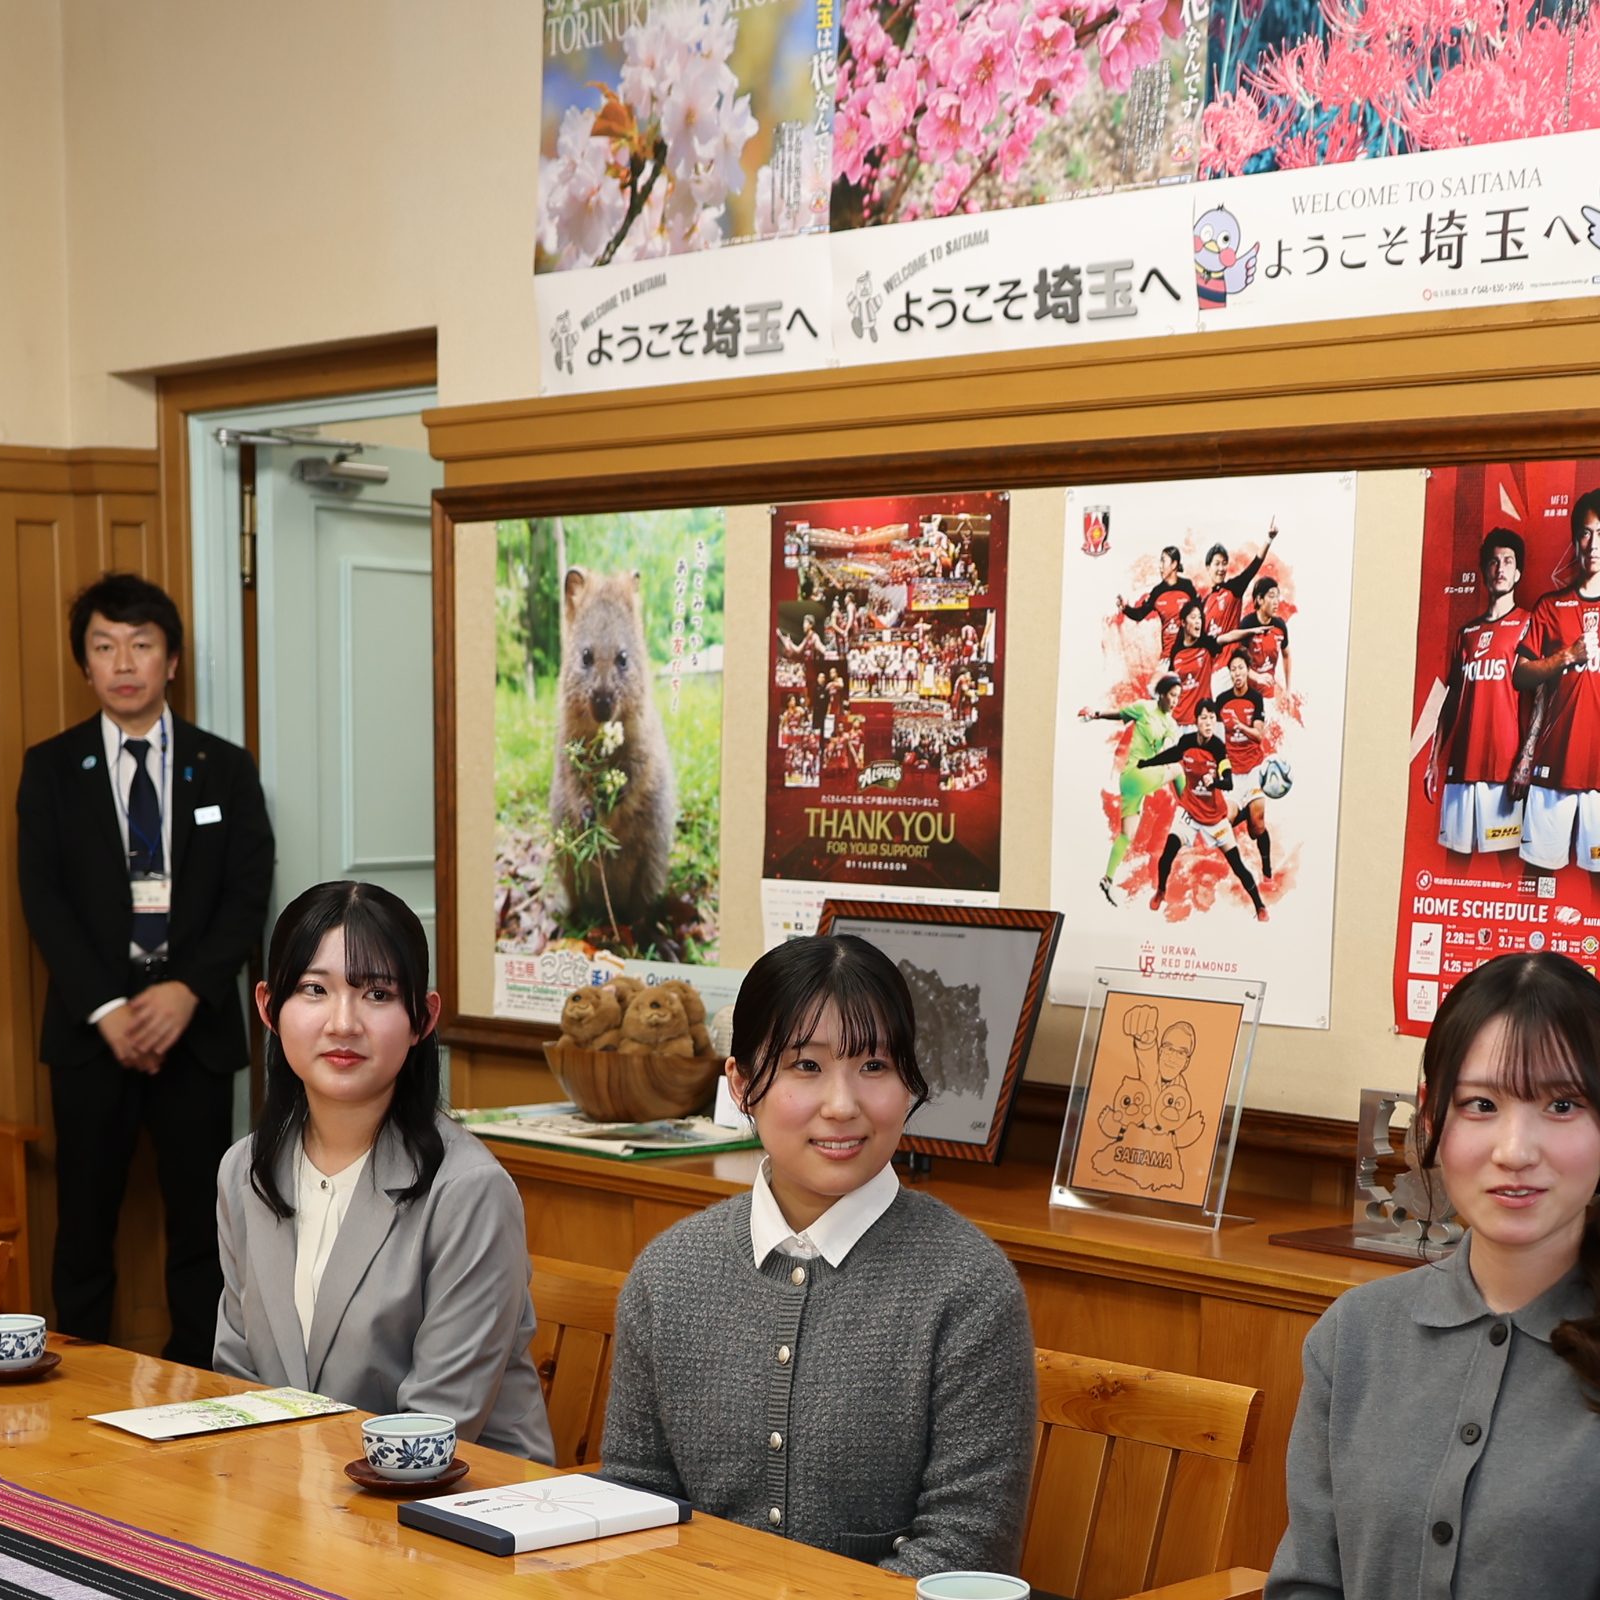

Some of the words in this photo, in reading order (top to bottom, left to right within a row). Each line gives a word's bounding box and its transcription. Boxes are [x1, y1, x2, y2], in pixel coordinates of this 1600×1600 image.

[809, 0, 838, 174] 玉は花なんです
[1292, 184, 1399, 216] WELCOME
[1406, 180, 1435, 203] TO
[1441, 166, 1543, 199] SAITAMA
[1265, 205, 1582, 280] ようこそ埼玉へ
[883, 256, 929, 294] WELCOME
[930, 245, 943, 263] TO
[945, 228, 990, 255] SAITAMA
[619, 286, 631, 304] TO
[894, 258, 1181, 333] ようこそ埼玉へ
[587, 300, 818, 366] ようこそ埼玉へ
[690, 540, 707, 667] きっとみつかる
[858, 766, 902, 789] ALPHAS
[804, 807, 894, 841] THANK
[899, 811, 955, 844] YOU
[1491, 825, 1520, 838] DHL
[826, 841, 847, 855] FOR
[849, 842, 878, 857] YOUR
[880, 843, 929, 858] SUPPORT
[872, 861, 908, 871] SEASON
[1413, 896, 1459, 916] HOME
[1462, 900, 1549, 923] SCHEDULE
[1445, 932, 1464, 944] 2.28
[1498, 935, 1513, 948] 3.7
[1551, 940, 1568, 952] 3.18
[1161, 945, 1197, 957] URAWA
[1161, 957, 1181, 969] RED
[1184, 959, 1238, 973] DIAMONDS
[1443, 960, 1461, 972] 4.25
[1114, 1146, 1172, 1169] SAITAMA
